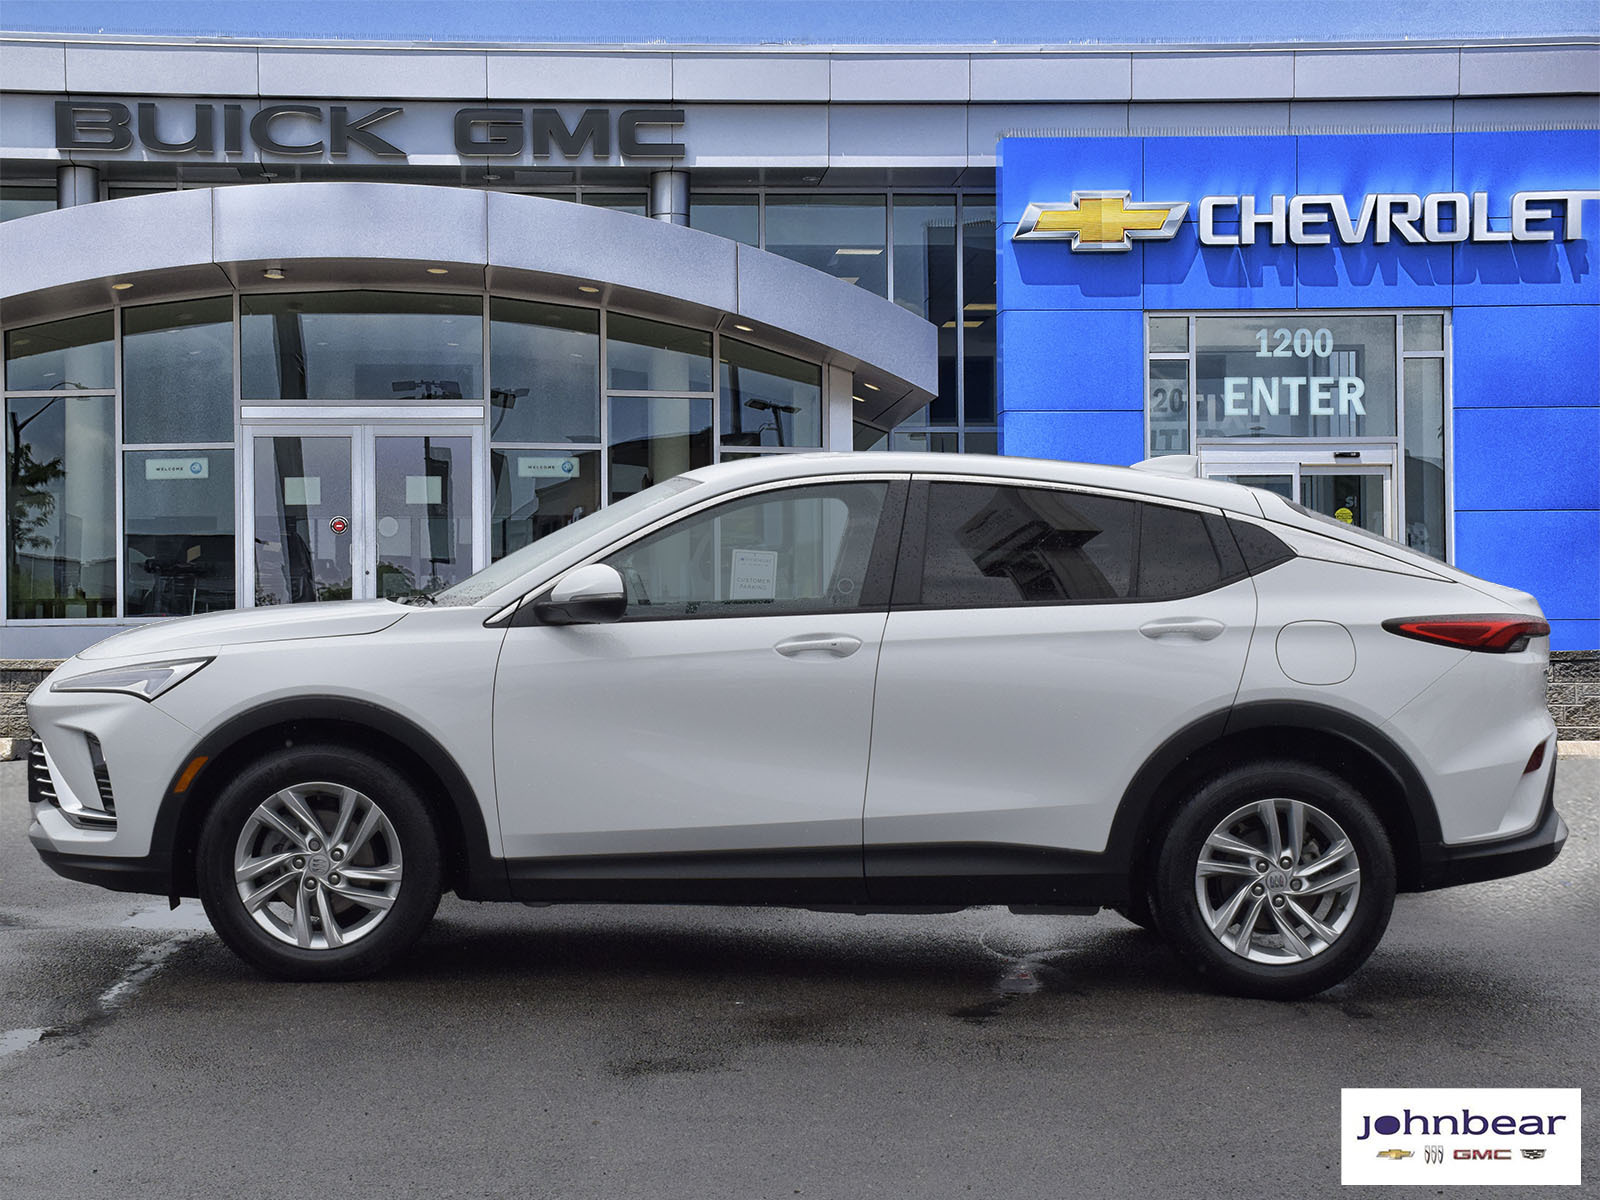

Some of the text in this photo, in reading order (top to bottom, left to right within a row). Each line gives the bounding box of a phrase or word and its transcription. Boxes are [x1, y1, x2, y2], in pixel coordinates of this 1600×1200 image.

[54, 100, 686, 158] BUICK GMC
[1199, 190, 1600, 245] CHEVROLET
[1255, 328, 1334, 358] 1200
[1223, 376, 1367, 416] ENTER
[736, 576, 770, 584] CUSTOMER
[739, 583, 767, 591] PARKING
